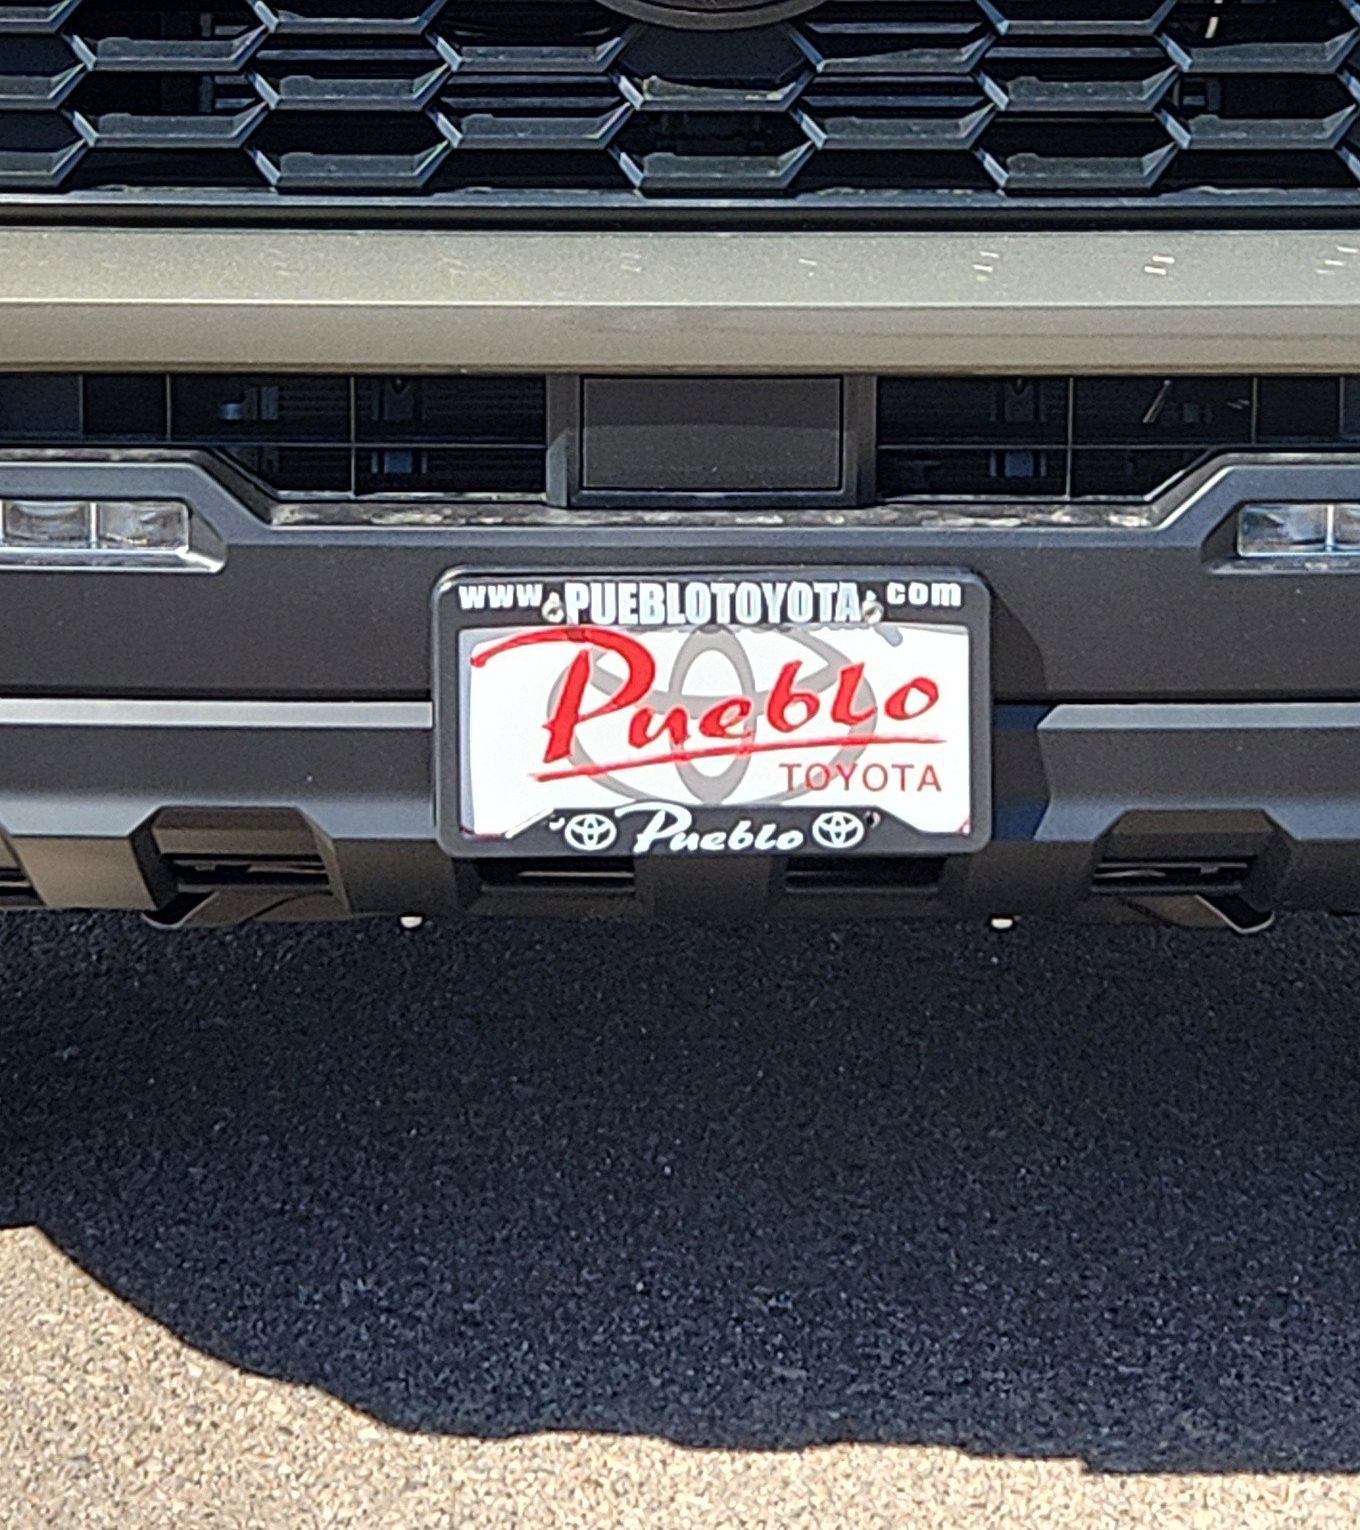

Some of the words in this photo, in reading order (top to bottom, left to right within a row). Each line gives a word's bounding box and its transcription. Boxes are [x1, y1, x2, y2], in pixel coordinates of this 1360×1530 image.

[471, 628, 940, 763] Pueblo
[778, 763, 942, 793] TOYOTA
[614, 801, 804, 854] Pueblo
